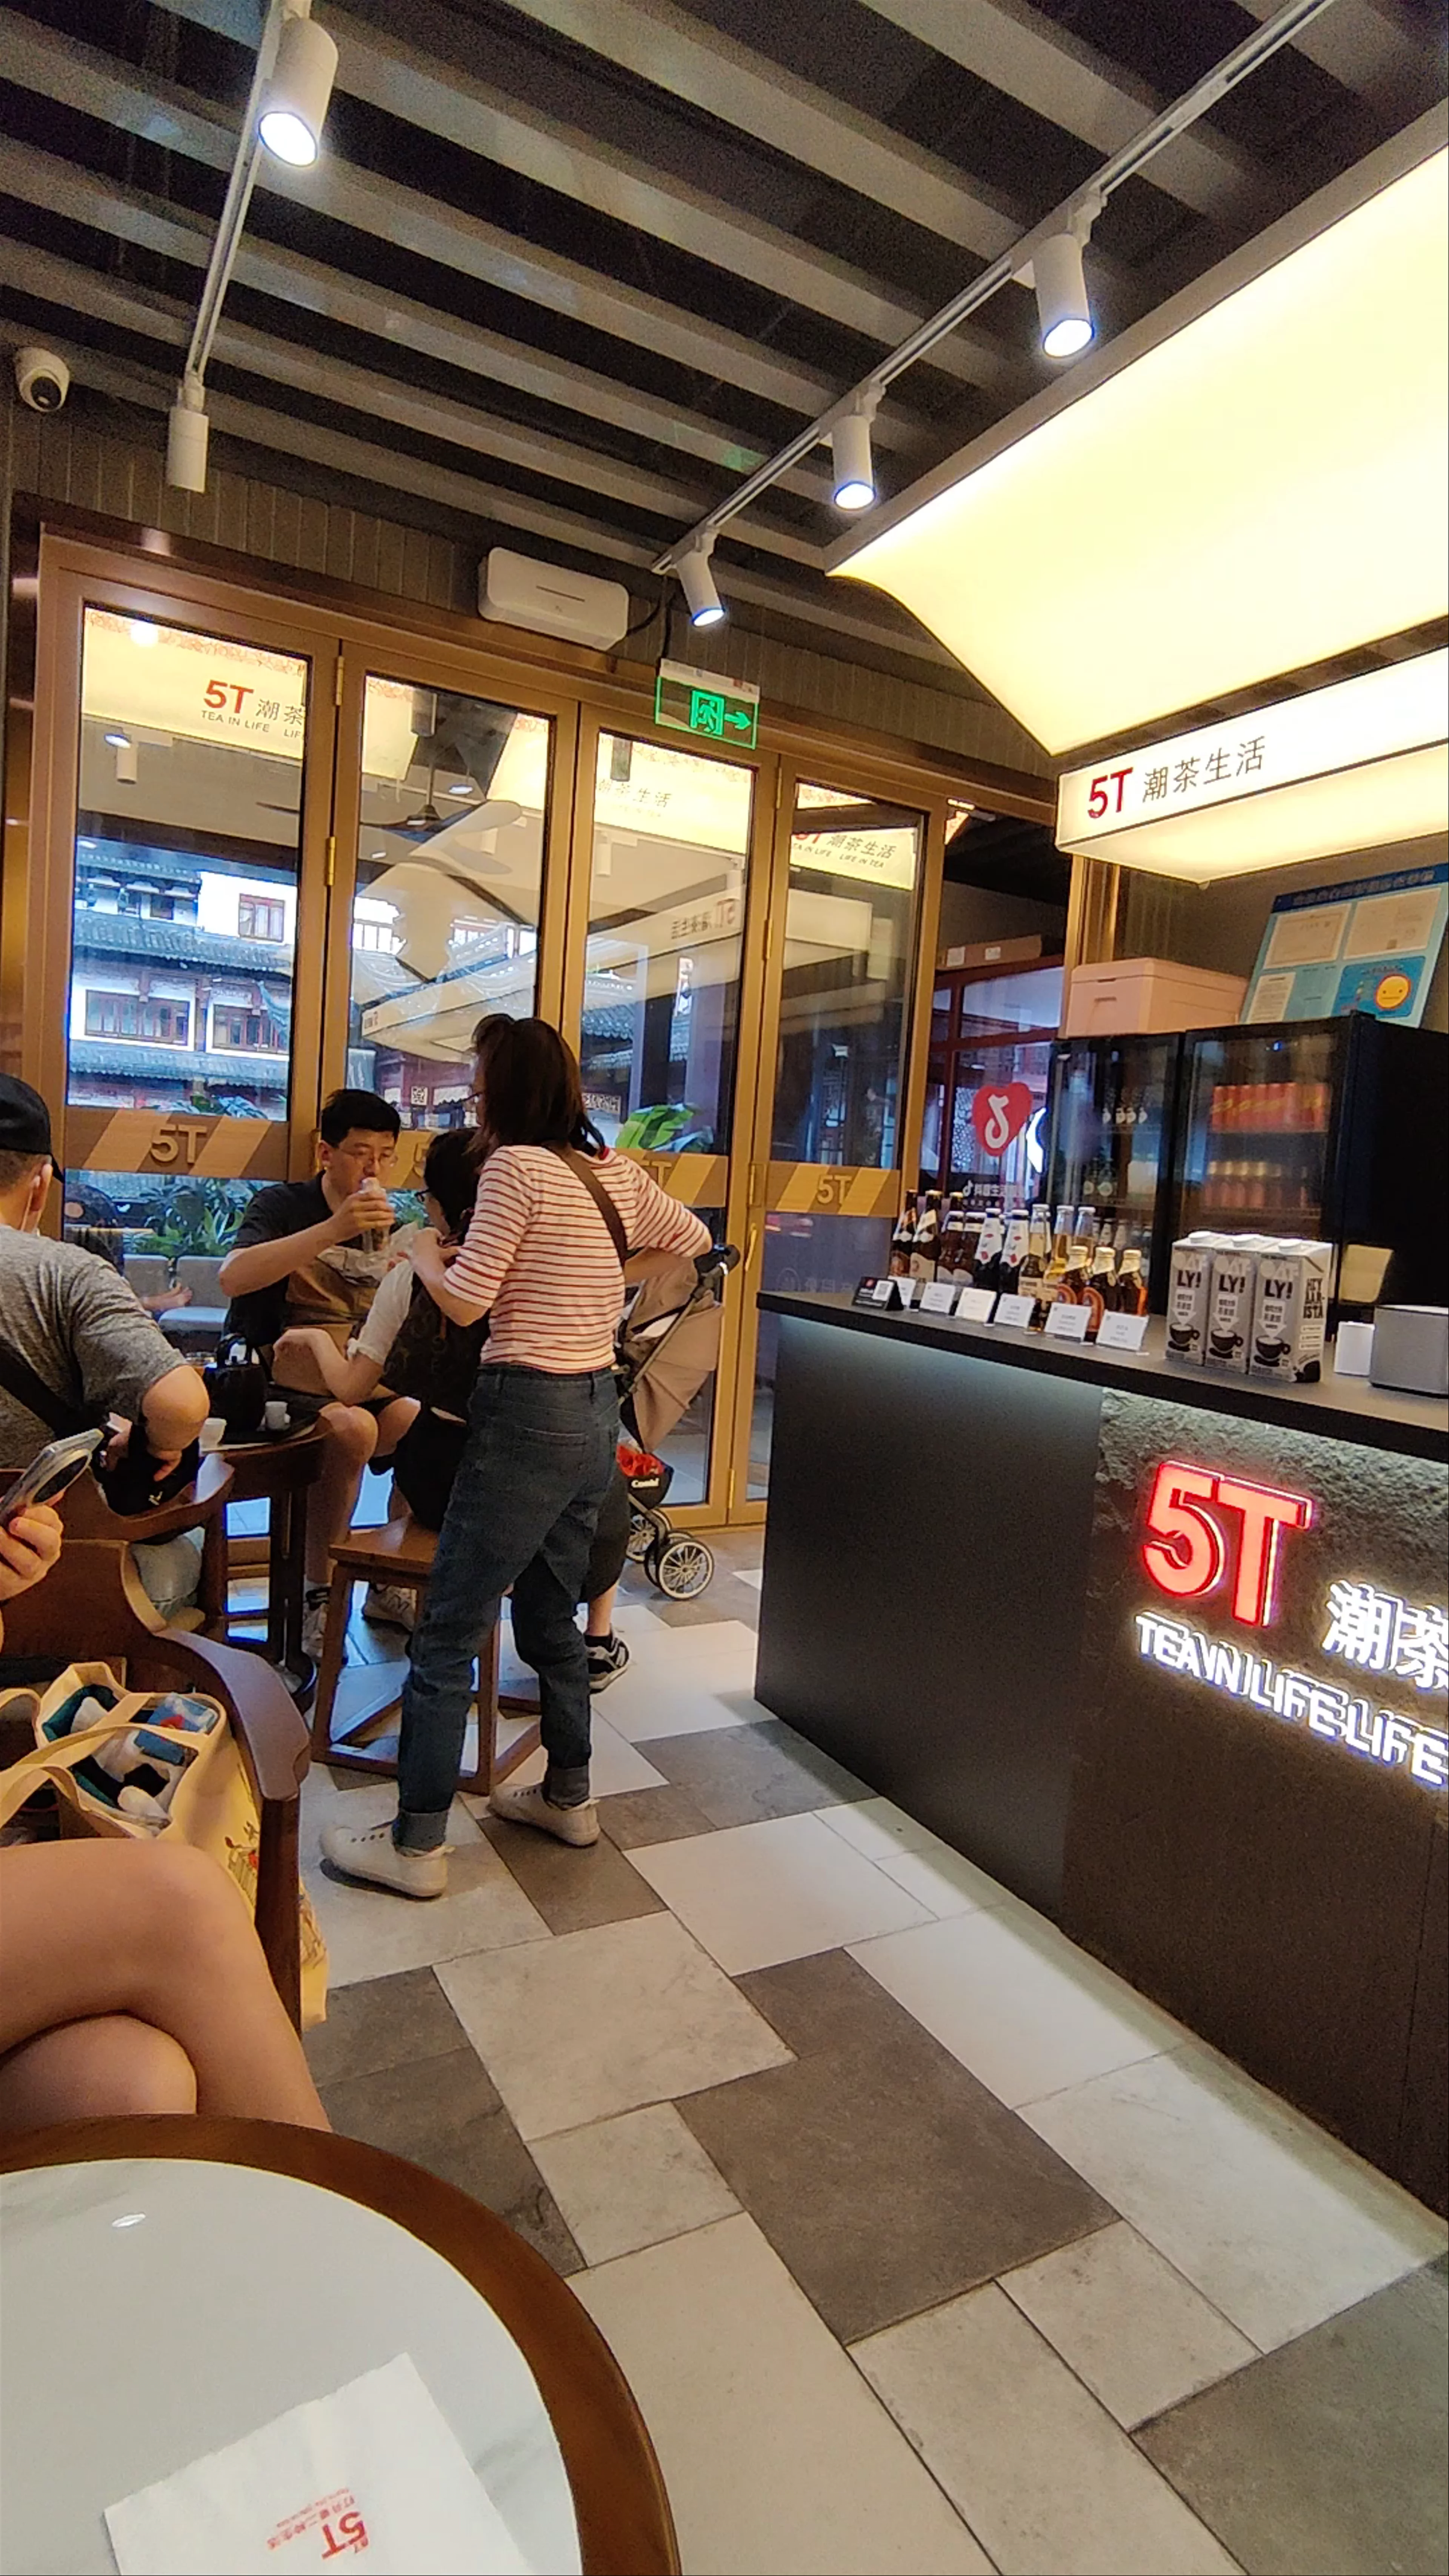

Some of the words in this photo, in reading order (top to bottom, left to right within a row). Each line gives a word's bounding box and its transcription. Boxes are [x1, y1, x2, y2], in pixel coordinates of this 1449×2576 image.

[203, 680, 254, 714] 5T
[202, 710, 224, 723] TEA
[228, 717, 240, 726] IN
[245, 720, 270, 732] LIFE
[284, 729, 302, 738] LIF
[1087, 767, 1134, 818] 5T
[1142, 736, 1266, 803] 潮茶生活
[151, 1124, 208, 1164] 5T
[816, 1174, 852, 1206] 5T
[1177, 1270, 1201, 1288] LY!
[1218, 1274, 1246, 1293] LY!
[1264, 1279, 1293, 1300] LY!
[1143, 1460, 1315, 1627] 5T
[1135, 1611, 1207, 1679] TEA
[1249, 1655, 1349, 1737] LIFE
[1344, 1699, 1449, 1787] LIFE
[322, 2512, 366, 2559] 5T
